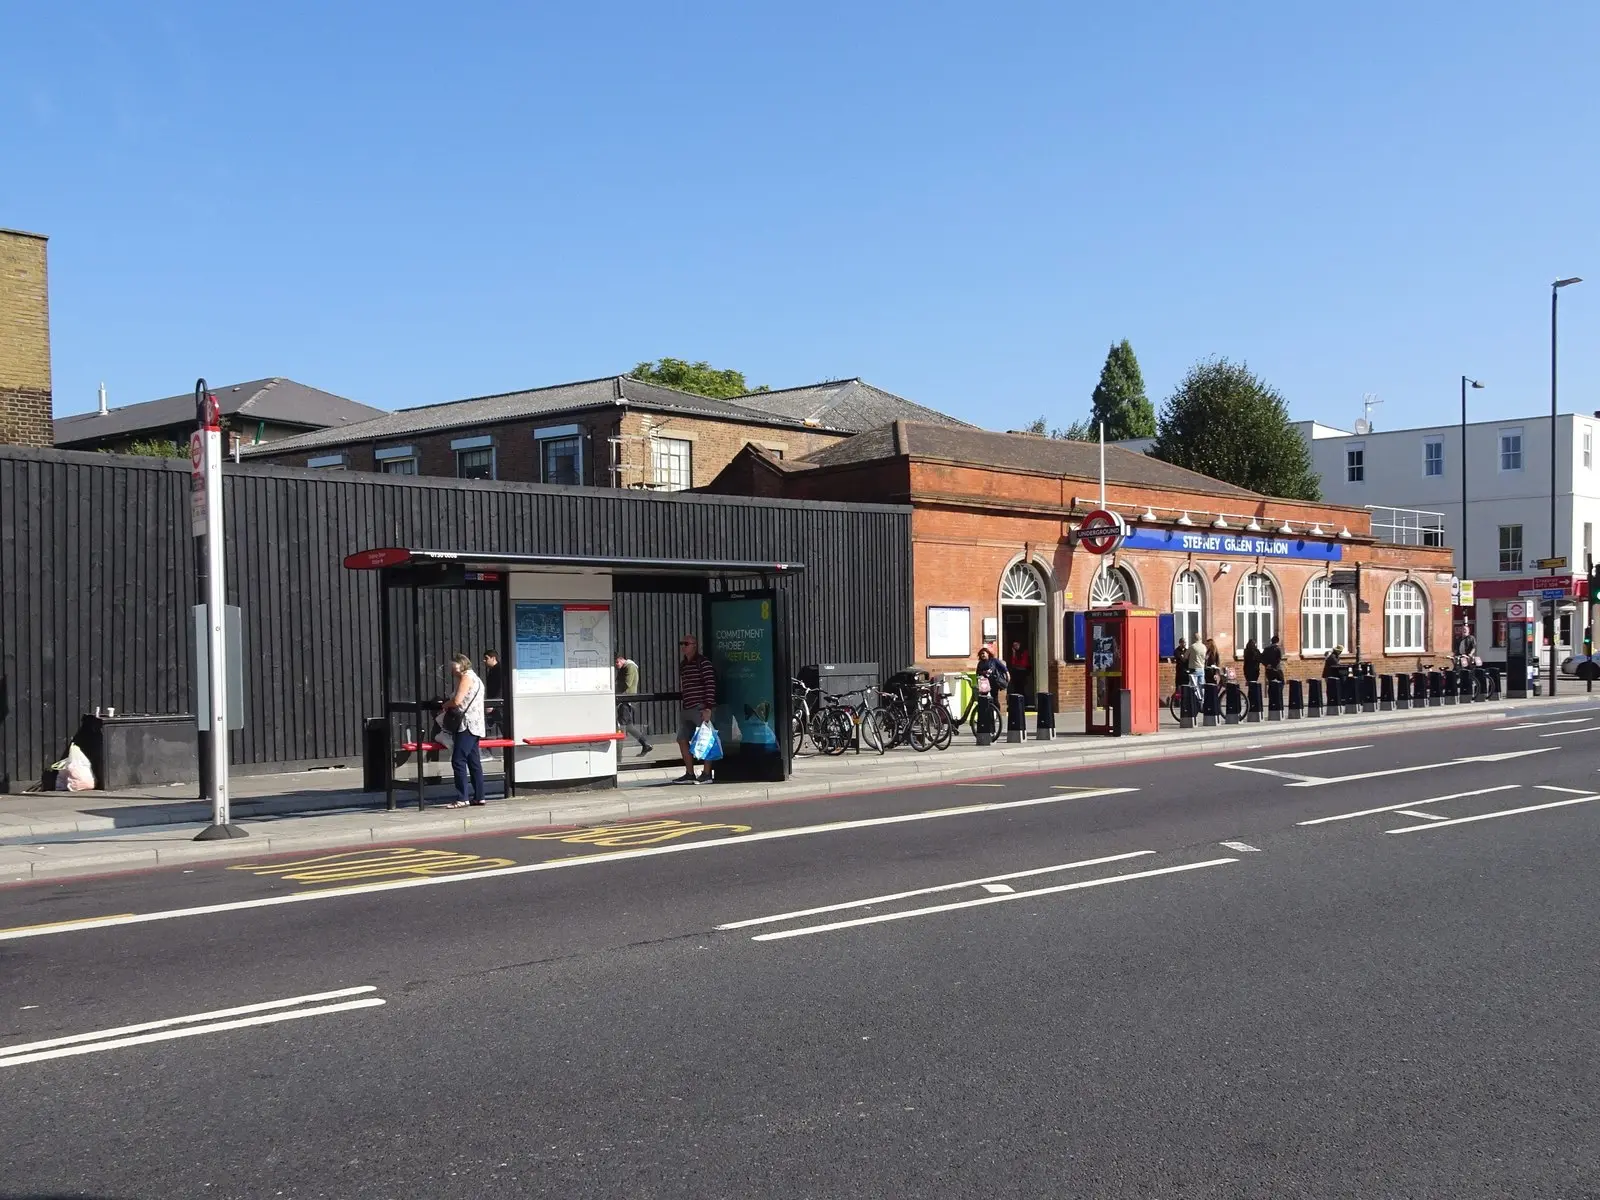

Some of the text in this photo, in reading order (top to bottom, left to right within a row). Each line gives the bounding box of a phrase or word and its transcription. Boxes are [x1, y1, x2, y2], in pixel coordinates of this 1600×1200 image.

[1077, 527, 1120, 537] UNDERGROUND
[1182, 535, 1288, 554] STEPNEY GREEN STATION
[716, 629, 764, 640] COMMITMENT
[718, 641, 745, 650] PHOBE?
[516, 820, 752, 846] BUS
[225, 847, 517, 884] STOP
